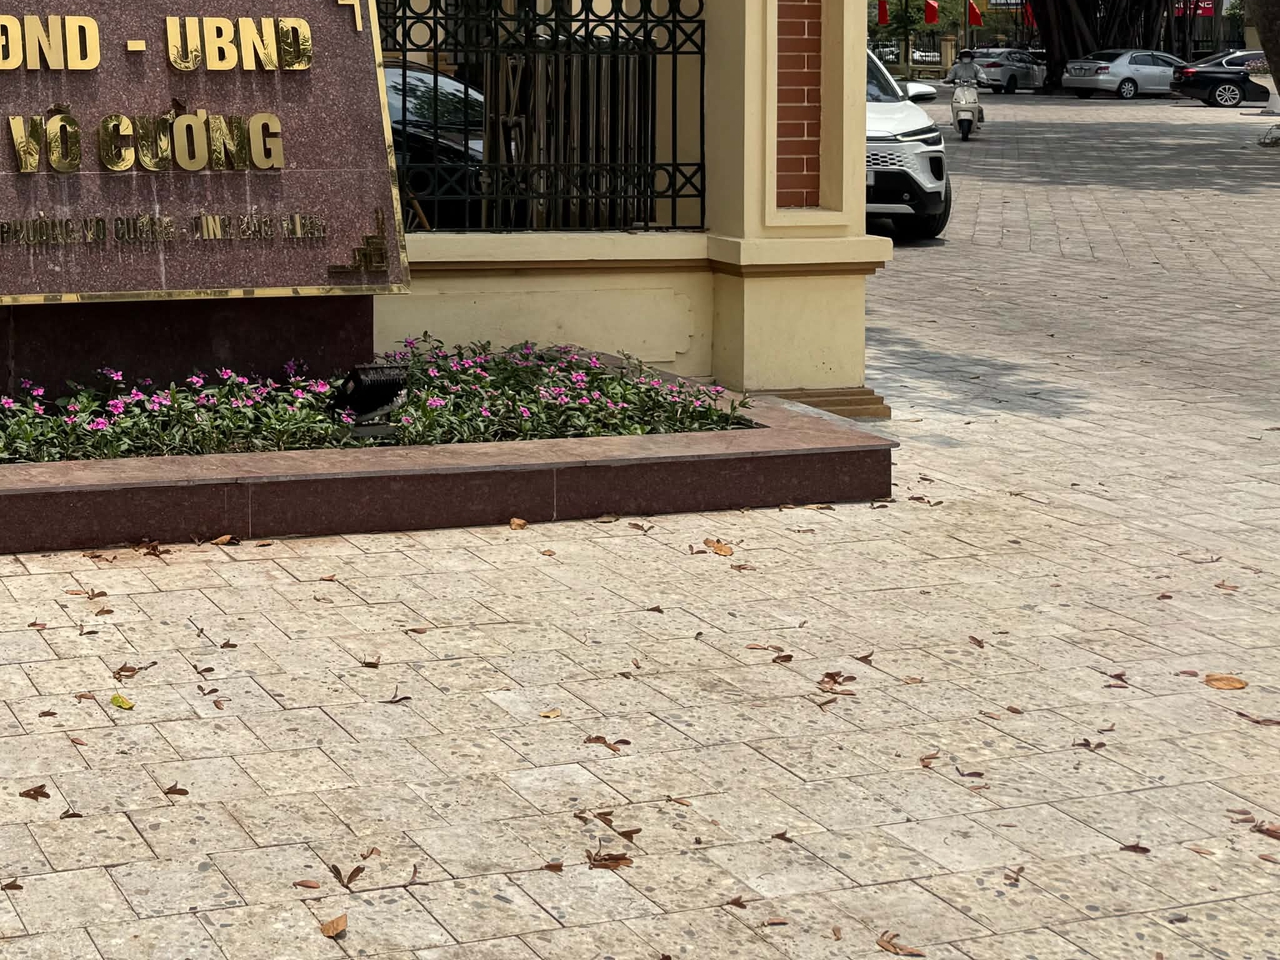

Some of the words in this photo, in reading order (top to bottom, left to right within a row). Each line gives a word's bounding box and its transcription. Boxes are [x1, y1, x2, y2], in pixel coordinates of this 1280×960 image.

[127, 40, 146, 51] -
[166, 16, 313, 72] UBND
[9, 103, 82, 173] VÕ
[98, 98, 285, 172] CƯỜNG
